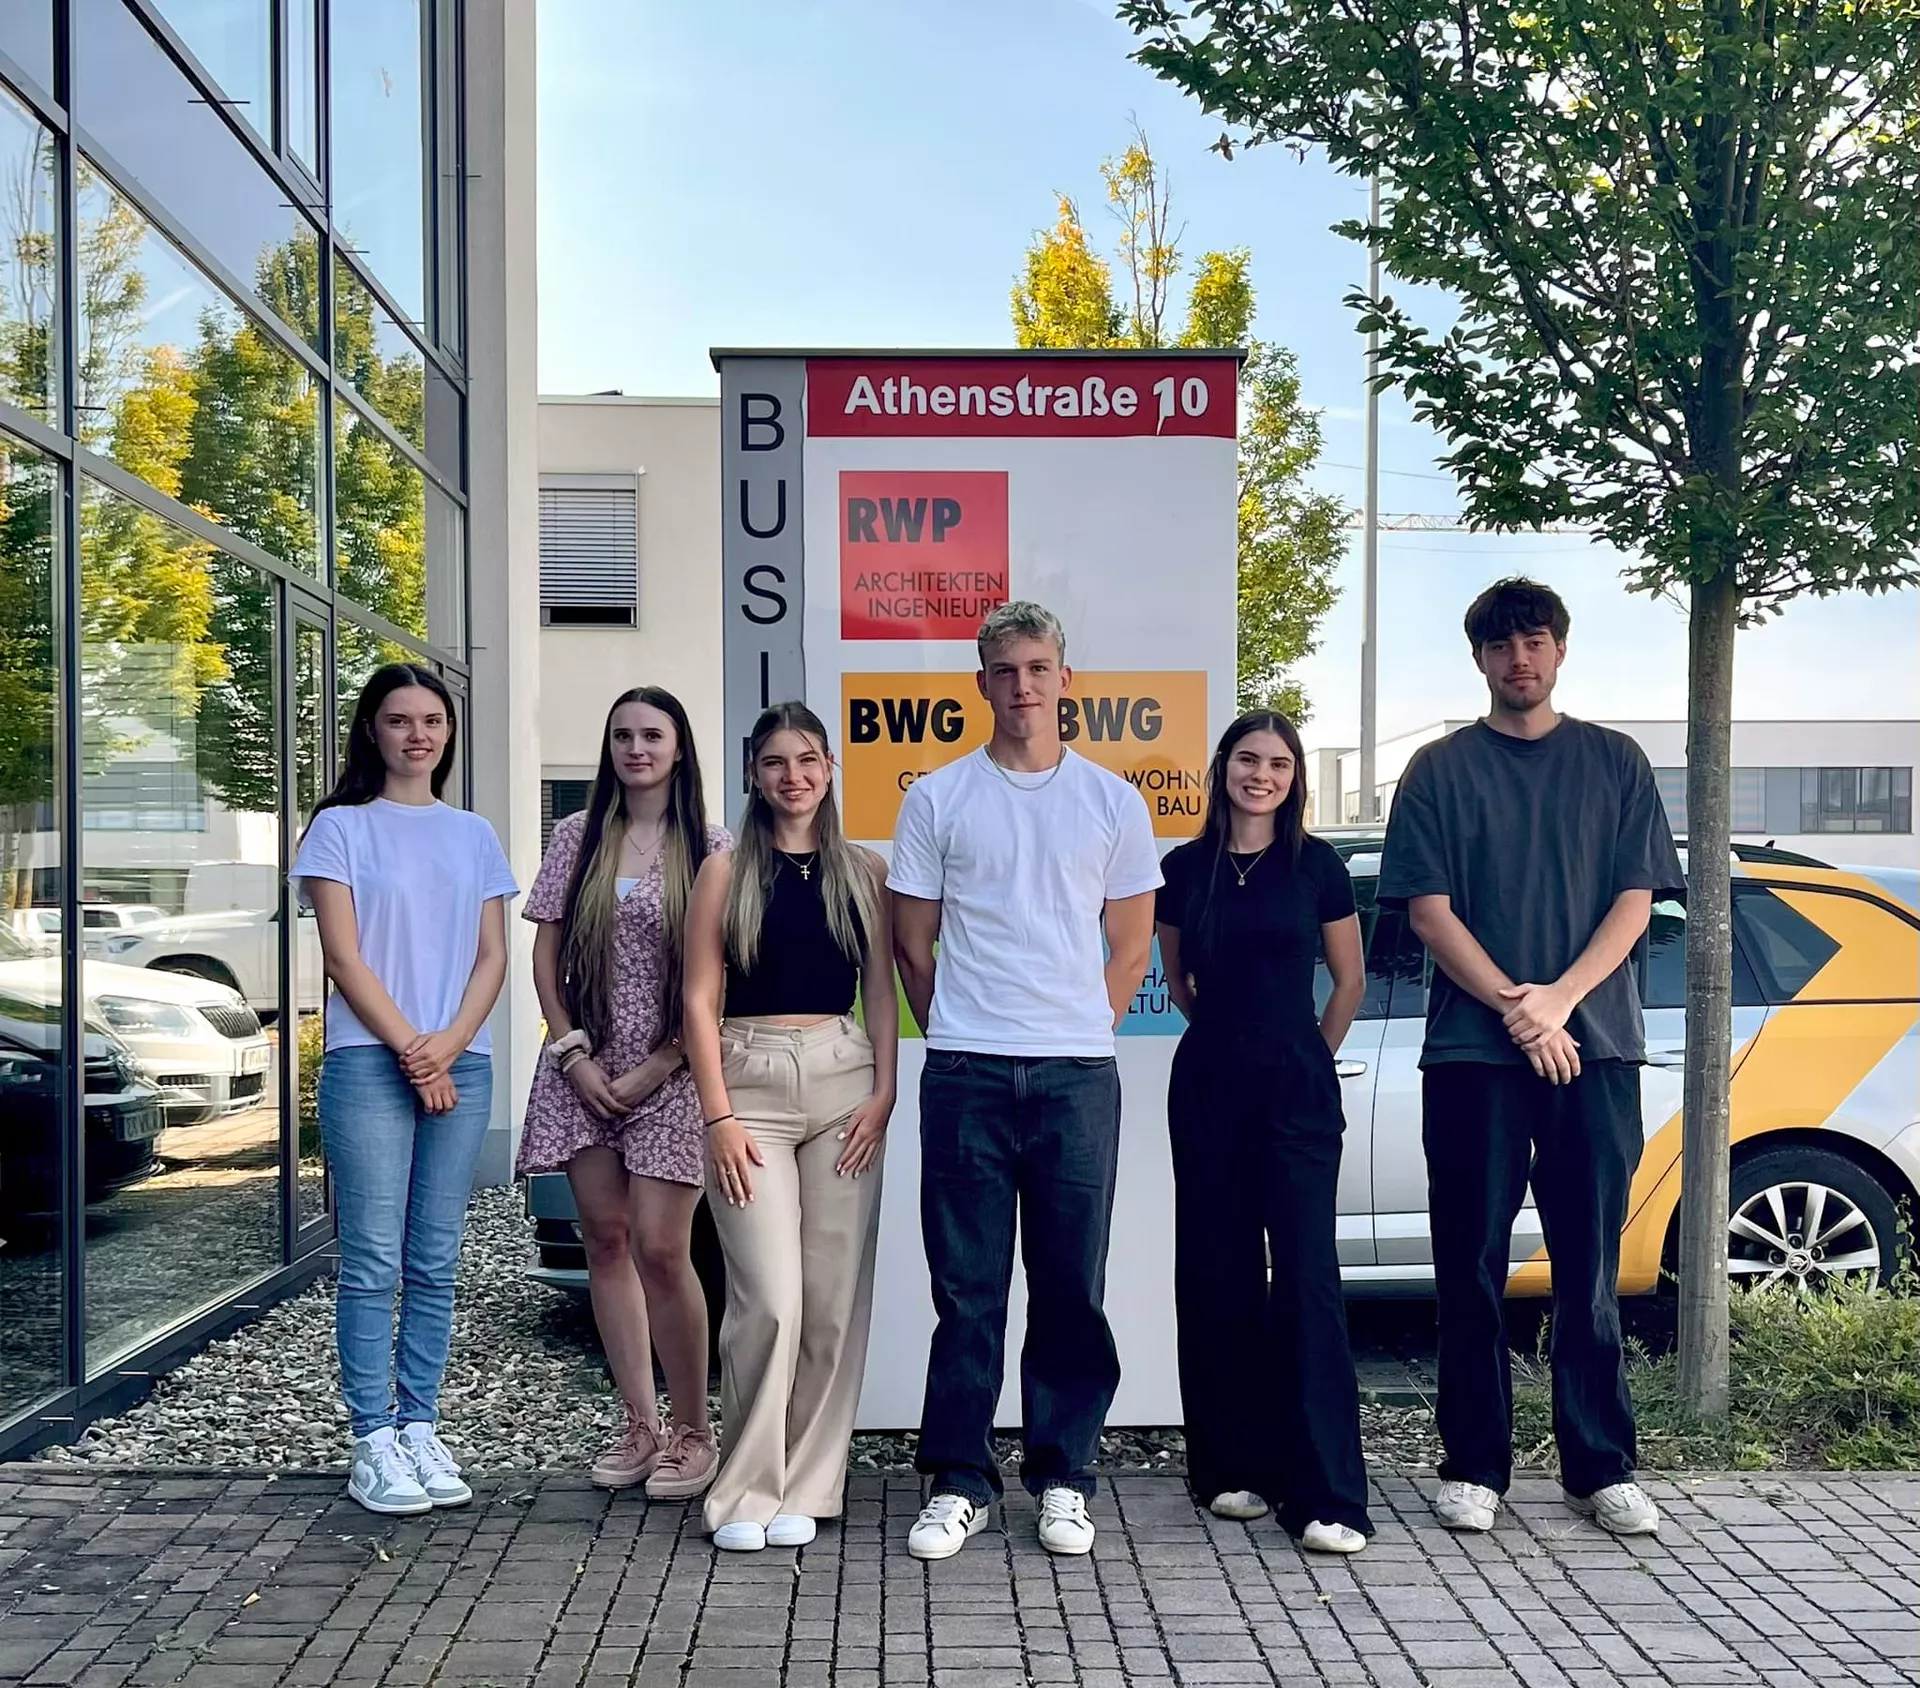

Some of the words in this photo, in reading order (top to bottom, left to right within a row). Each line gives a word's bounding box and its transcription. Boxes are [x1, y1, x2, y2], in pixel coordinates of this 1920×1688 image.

[843, 375, 1138, 418] Athenstraße
[1153, 376, 1210, 424] 10
[847, 498, 962, 543] RWP
[740, 393, 788, 794] BUSI
[854, 572, 1003, 592] ARCHITEKTEN
[849, 698, 964, 743] BWG
[1057, 697, 1163, 741] BWG
[1123, 770, 1201, 790] WOHN
[1157, 796, 1201, 816] BAU
